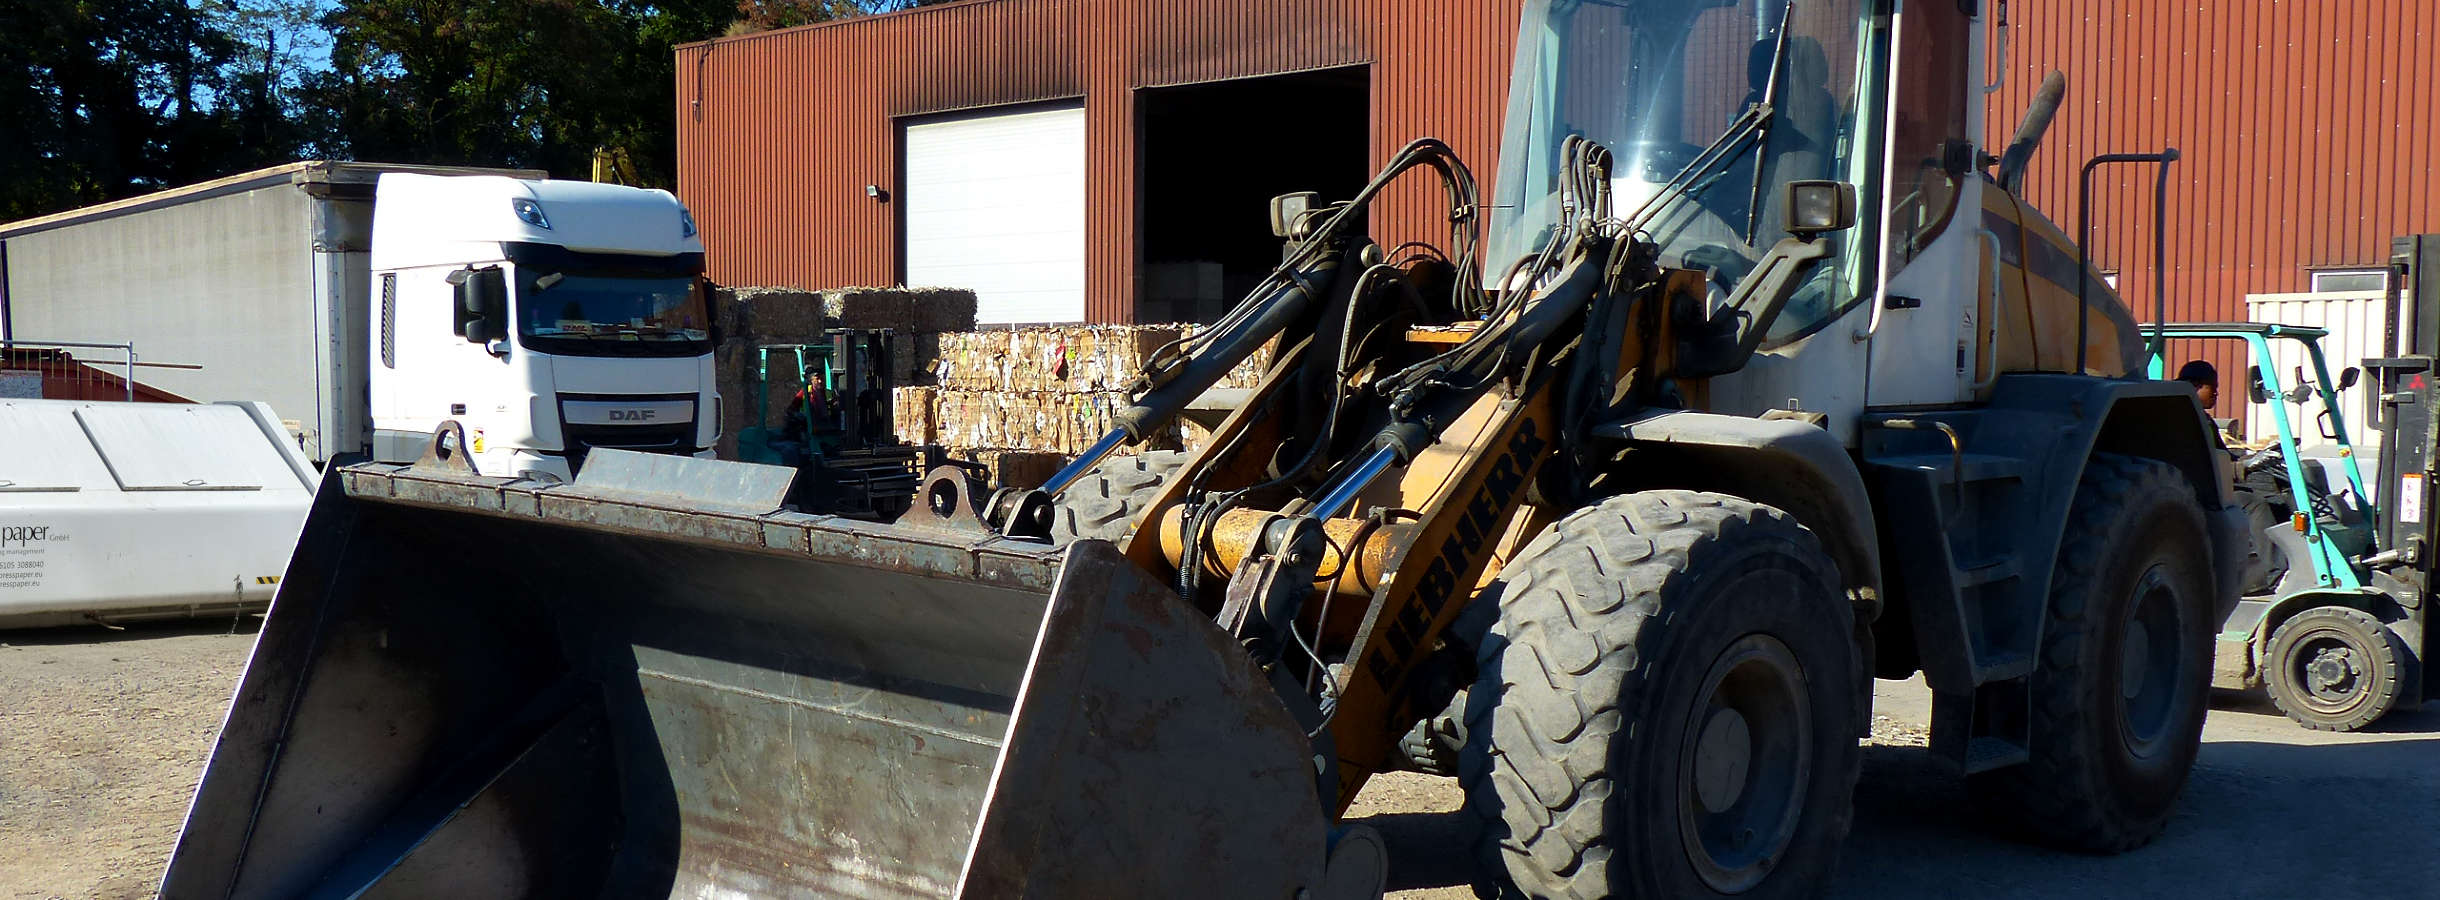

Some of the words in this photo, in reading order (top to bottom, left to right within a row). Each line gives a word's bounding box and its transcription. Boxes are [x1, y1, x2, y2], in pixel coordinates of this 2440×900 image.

[608, 409, 657, 421] DAF
[2, 526, 49, 548] paper
[1368, 416, 1547, 694] LIEBHERR
